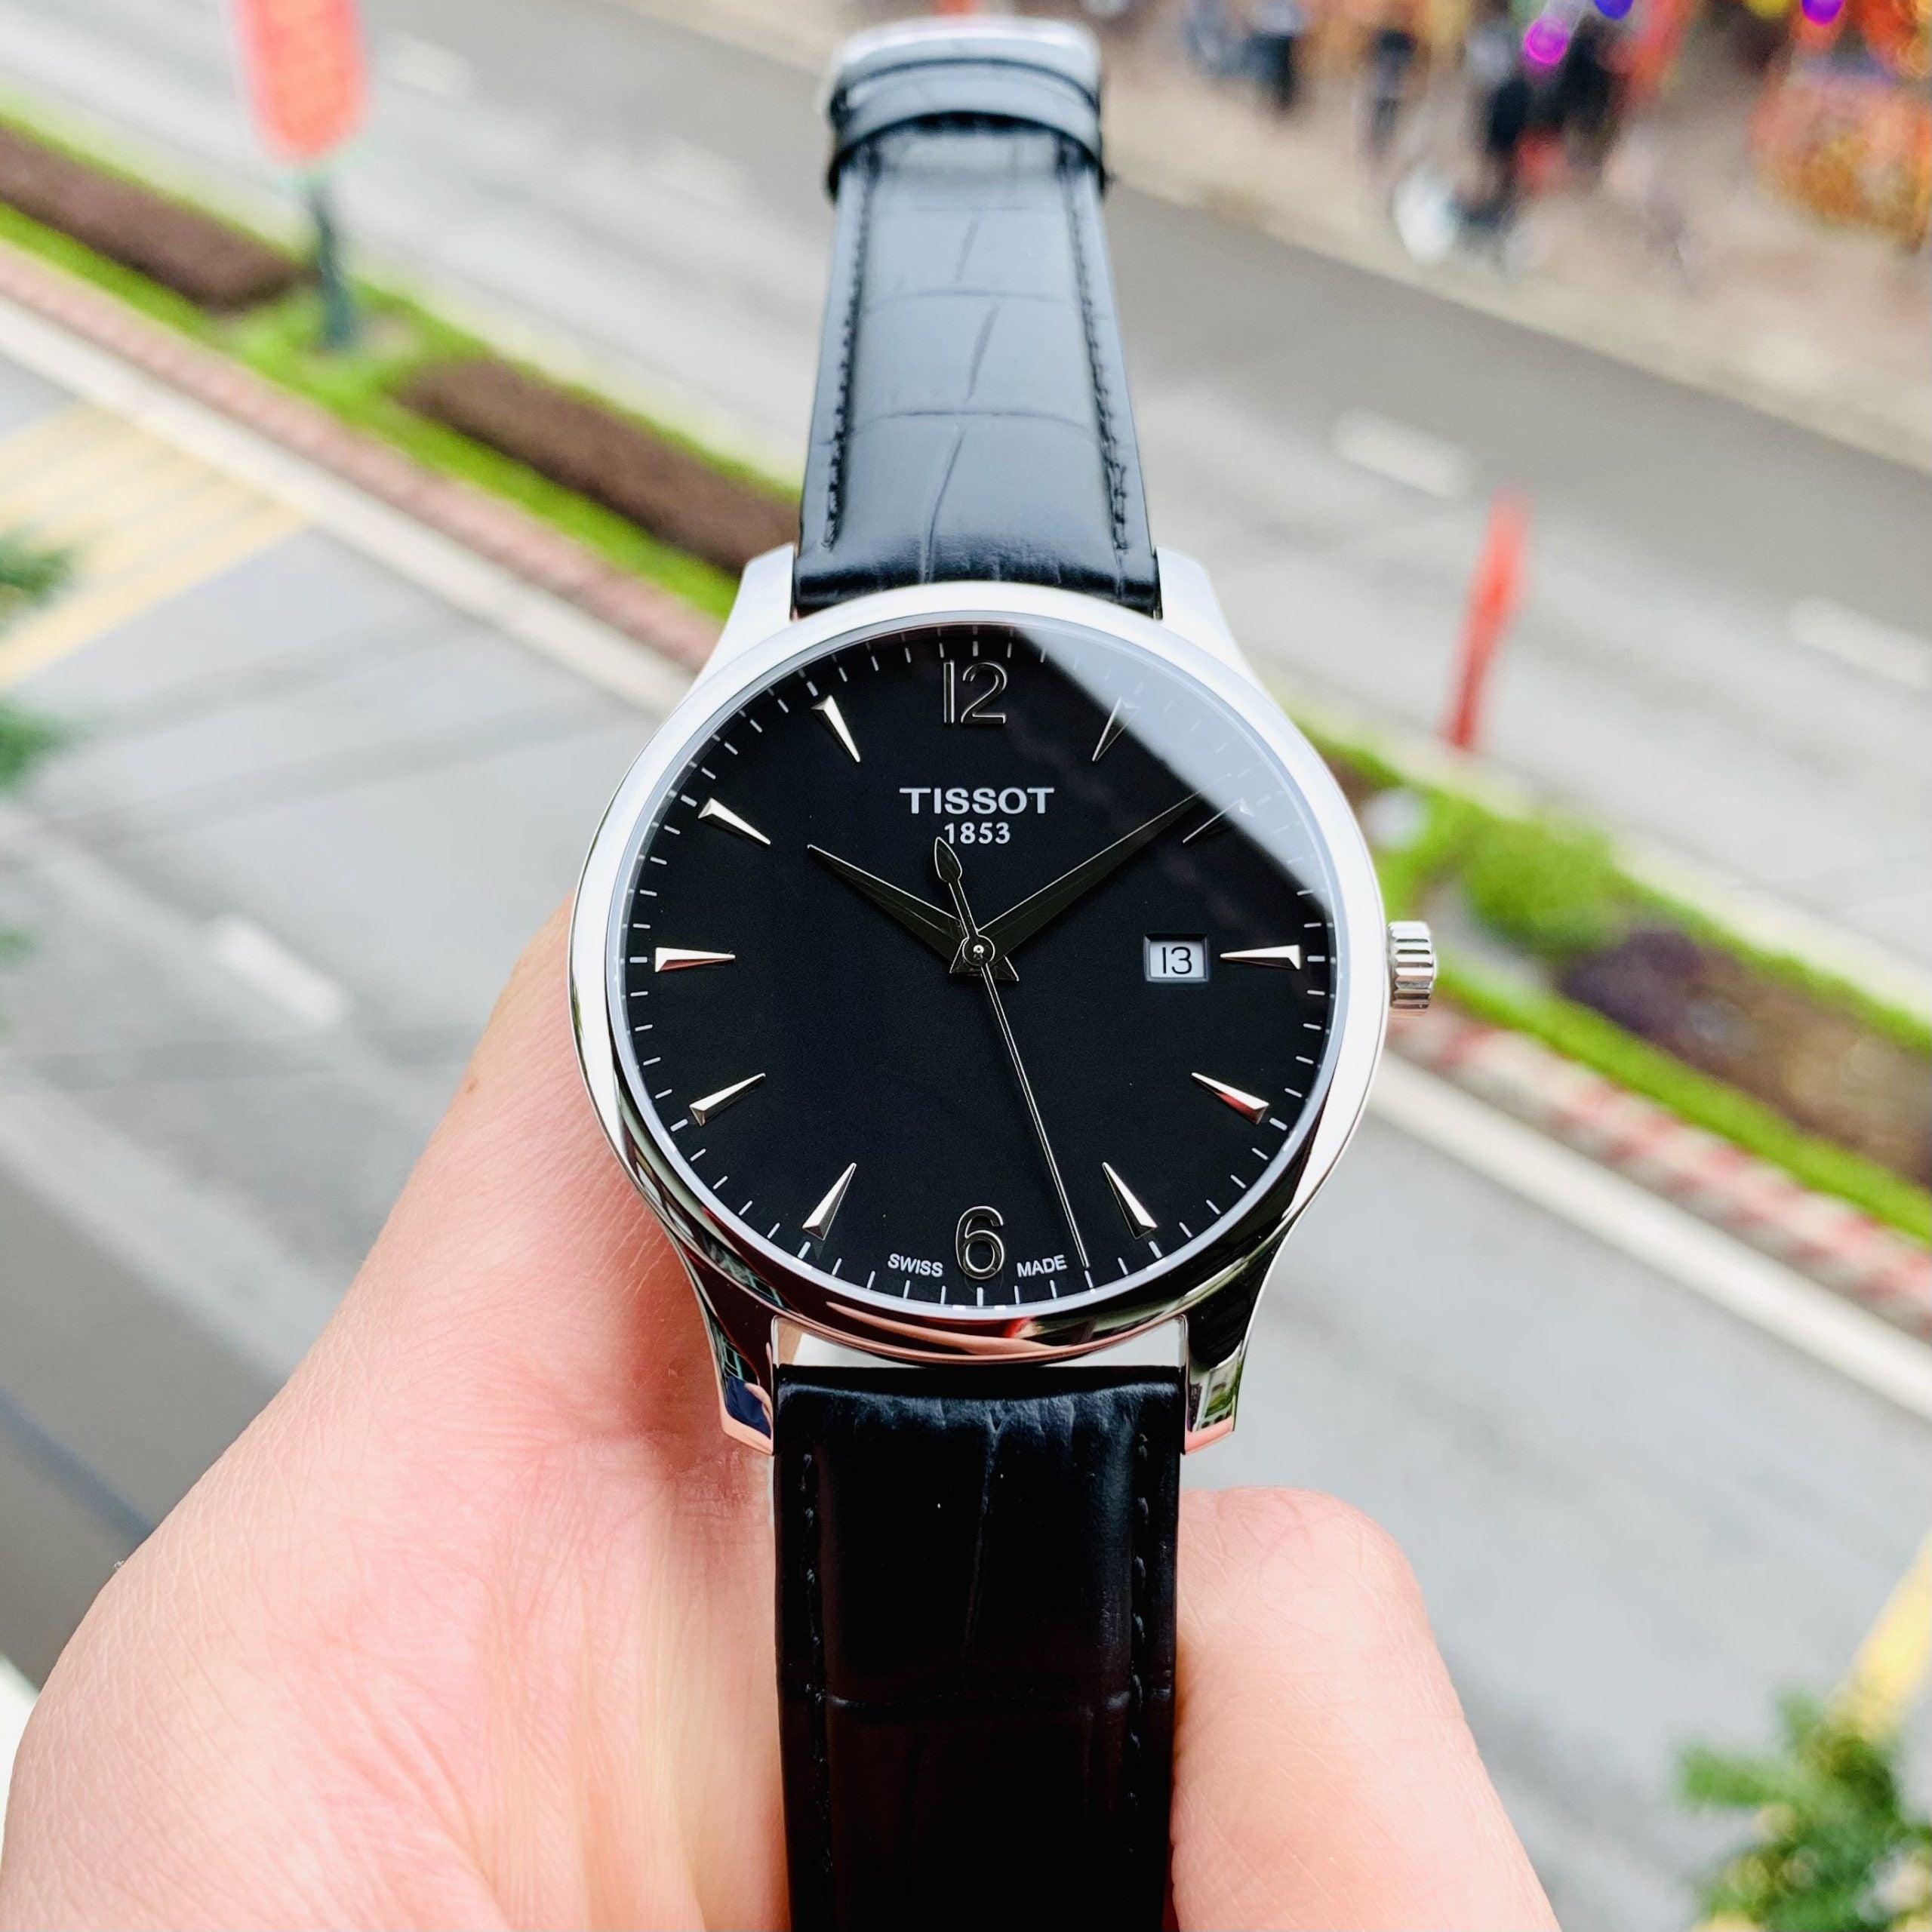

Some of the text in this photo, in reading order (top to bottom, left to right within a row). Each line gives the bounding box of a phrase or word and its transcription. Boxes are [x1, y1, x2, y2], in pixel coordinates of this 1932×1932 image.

[943, 660, 1008, 724] 12
[899, 787, 1055, 814] TISSOT
[944, 822, 1011, 844] 1853
[1161, 946, 1192, 975] 13
[955, 1205, 1005, 1280] 6
[888, 1253, 1069, 1278] SWISS MADE
